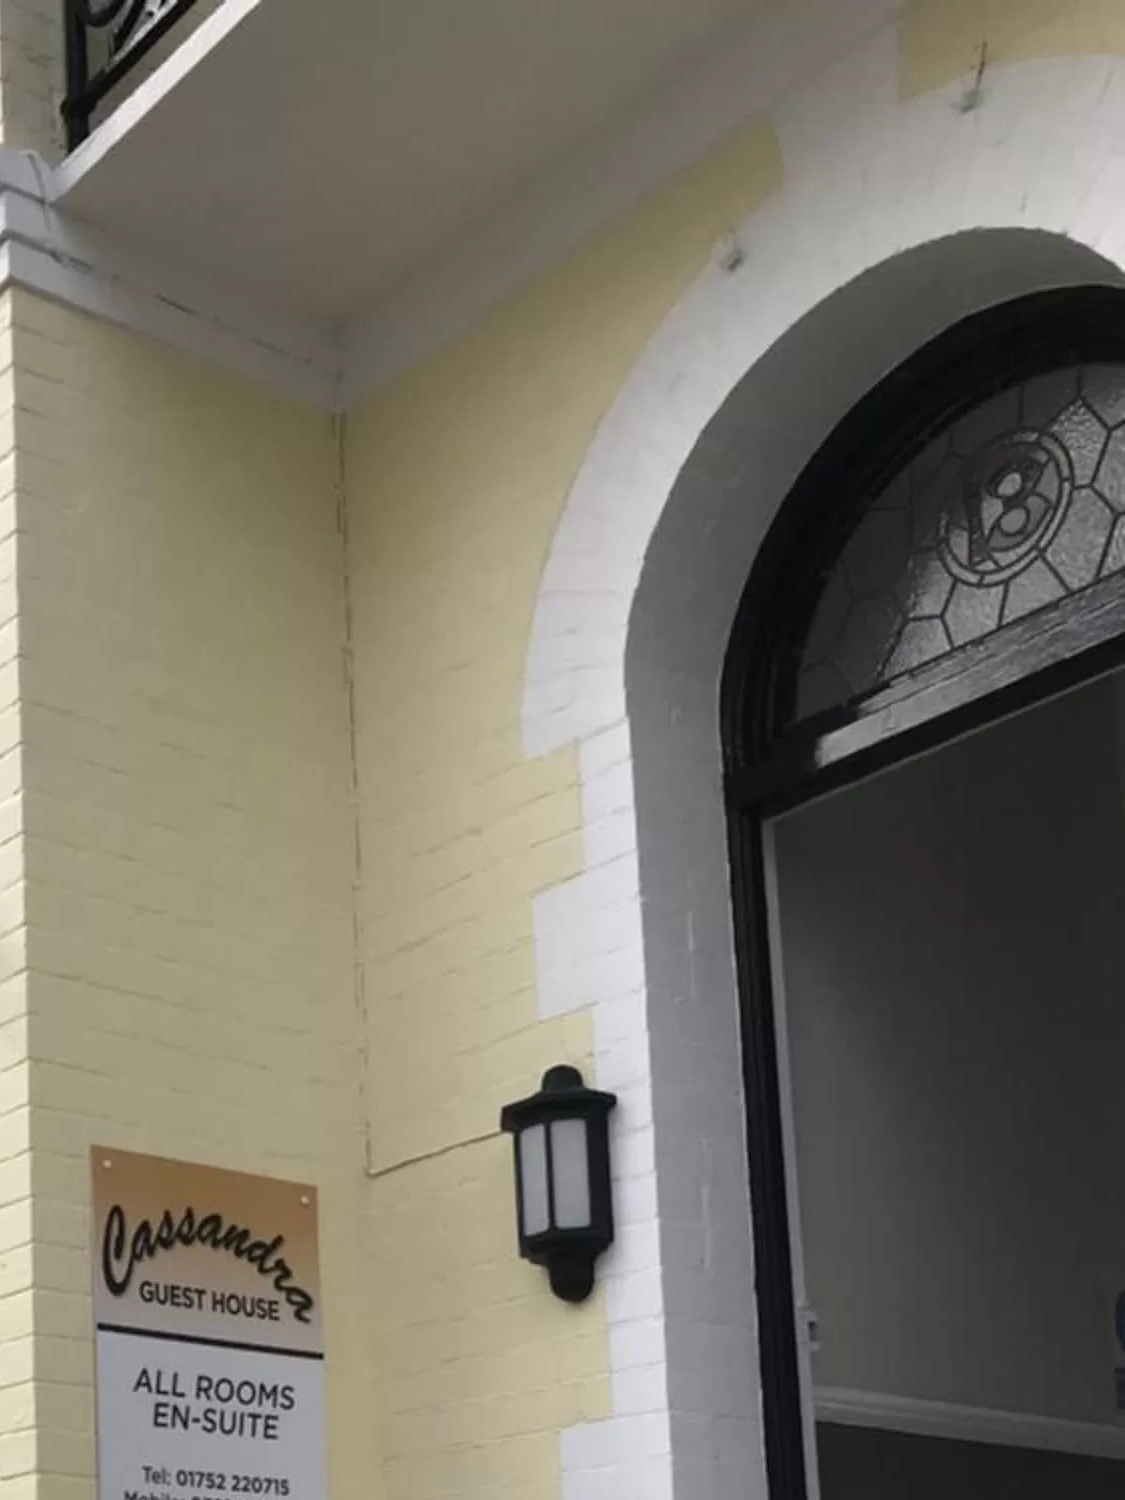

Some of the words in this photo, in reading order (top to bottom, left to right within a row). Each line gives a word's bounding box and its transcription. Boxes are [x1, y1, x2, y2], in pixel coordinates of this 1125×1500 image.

[102, 1204, 313, 1324] Cassandra
[139, 1280, 207, 1310] GUEST
[211, 1290, 280, 1321] HOUSE
[133, 1367, 186, 1398] ALL
[195, 1375, 295, 1410] ROOMS
[153, 1402, 280, 1440] EN-SUITE
[142, 1466, 171, 1486] Tel:
[176, 1469, 226, 1491] 01752
[231, 1474, 290, 1496] 220715
